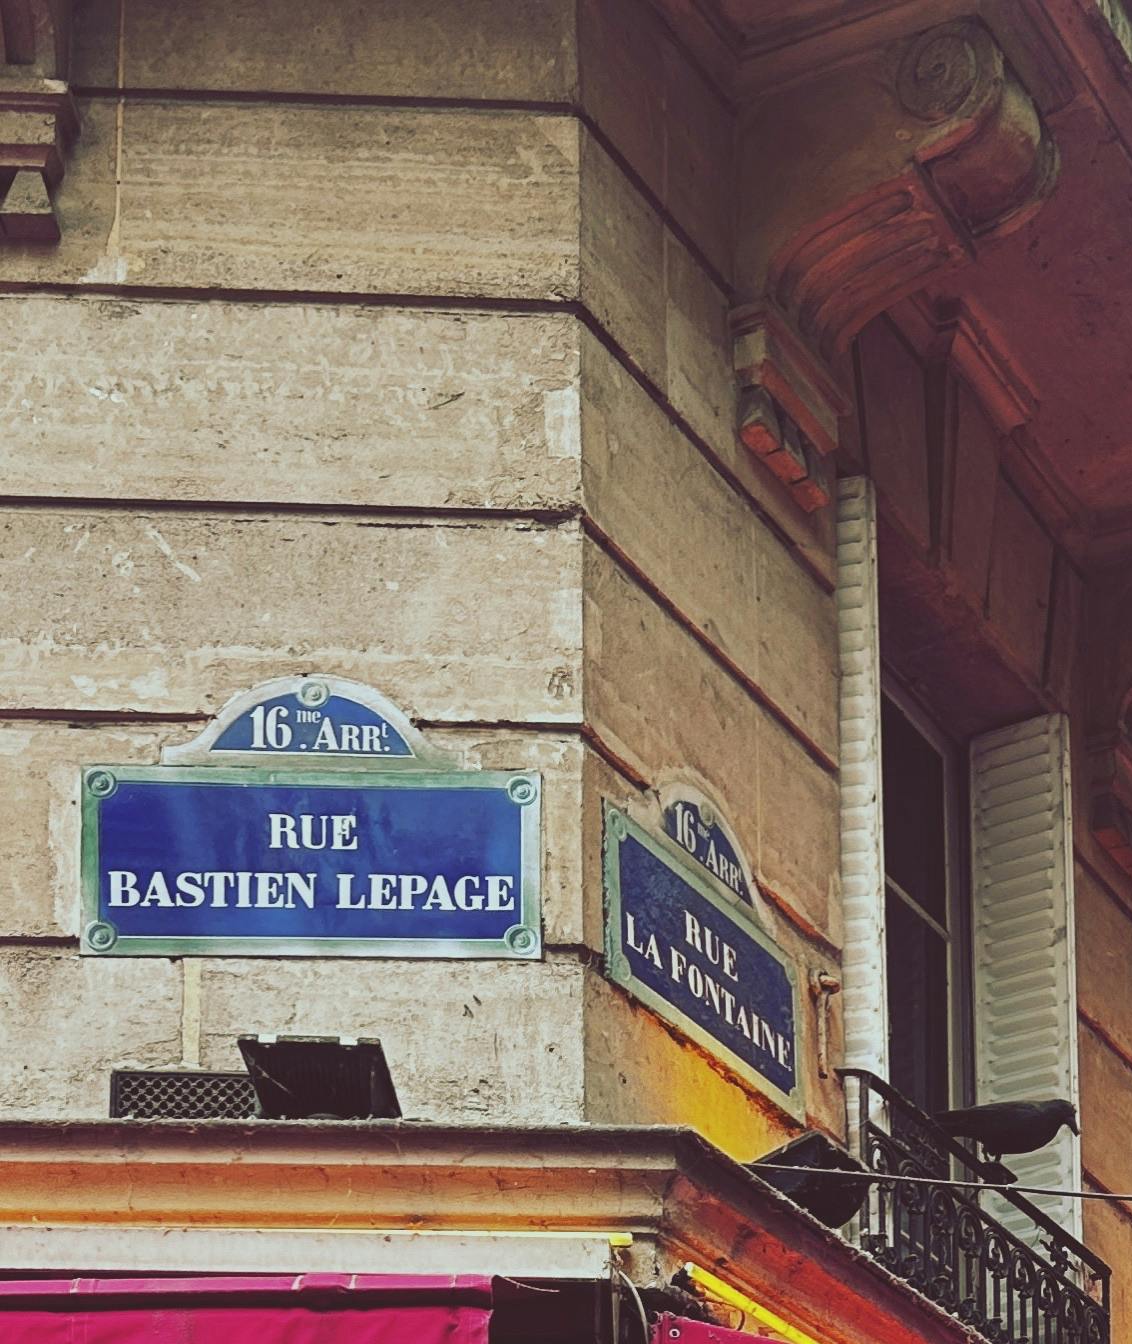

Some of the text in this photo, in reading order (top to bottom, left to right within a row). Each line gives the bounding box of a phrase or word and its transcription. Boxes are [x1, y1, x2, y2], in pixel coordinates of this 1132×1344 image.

[268, 813, 358, 851] RUE
[107, 870, 516, 912] BASTIEN LEPAGE
[683, 909, 739, 982] RUE
[625, 911, 792, 1072] LA FONTAINE
